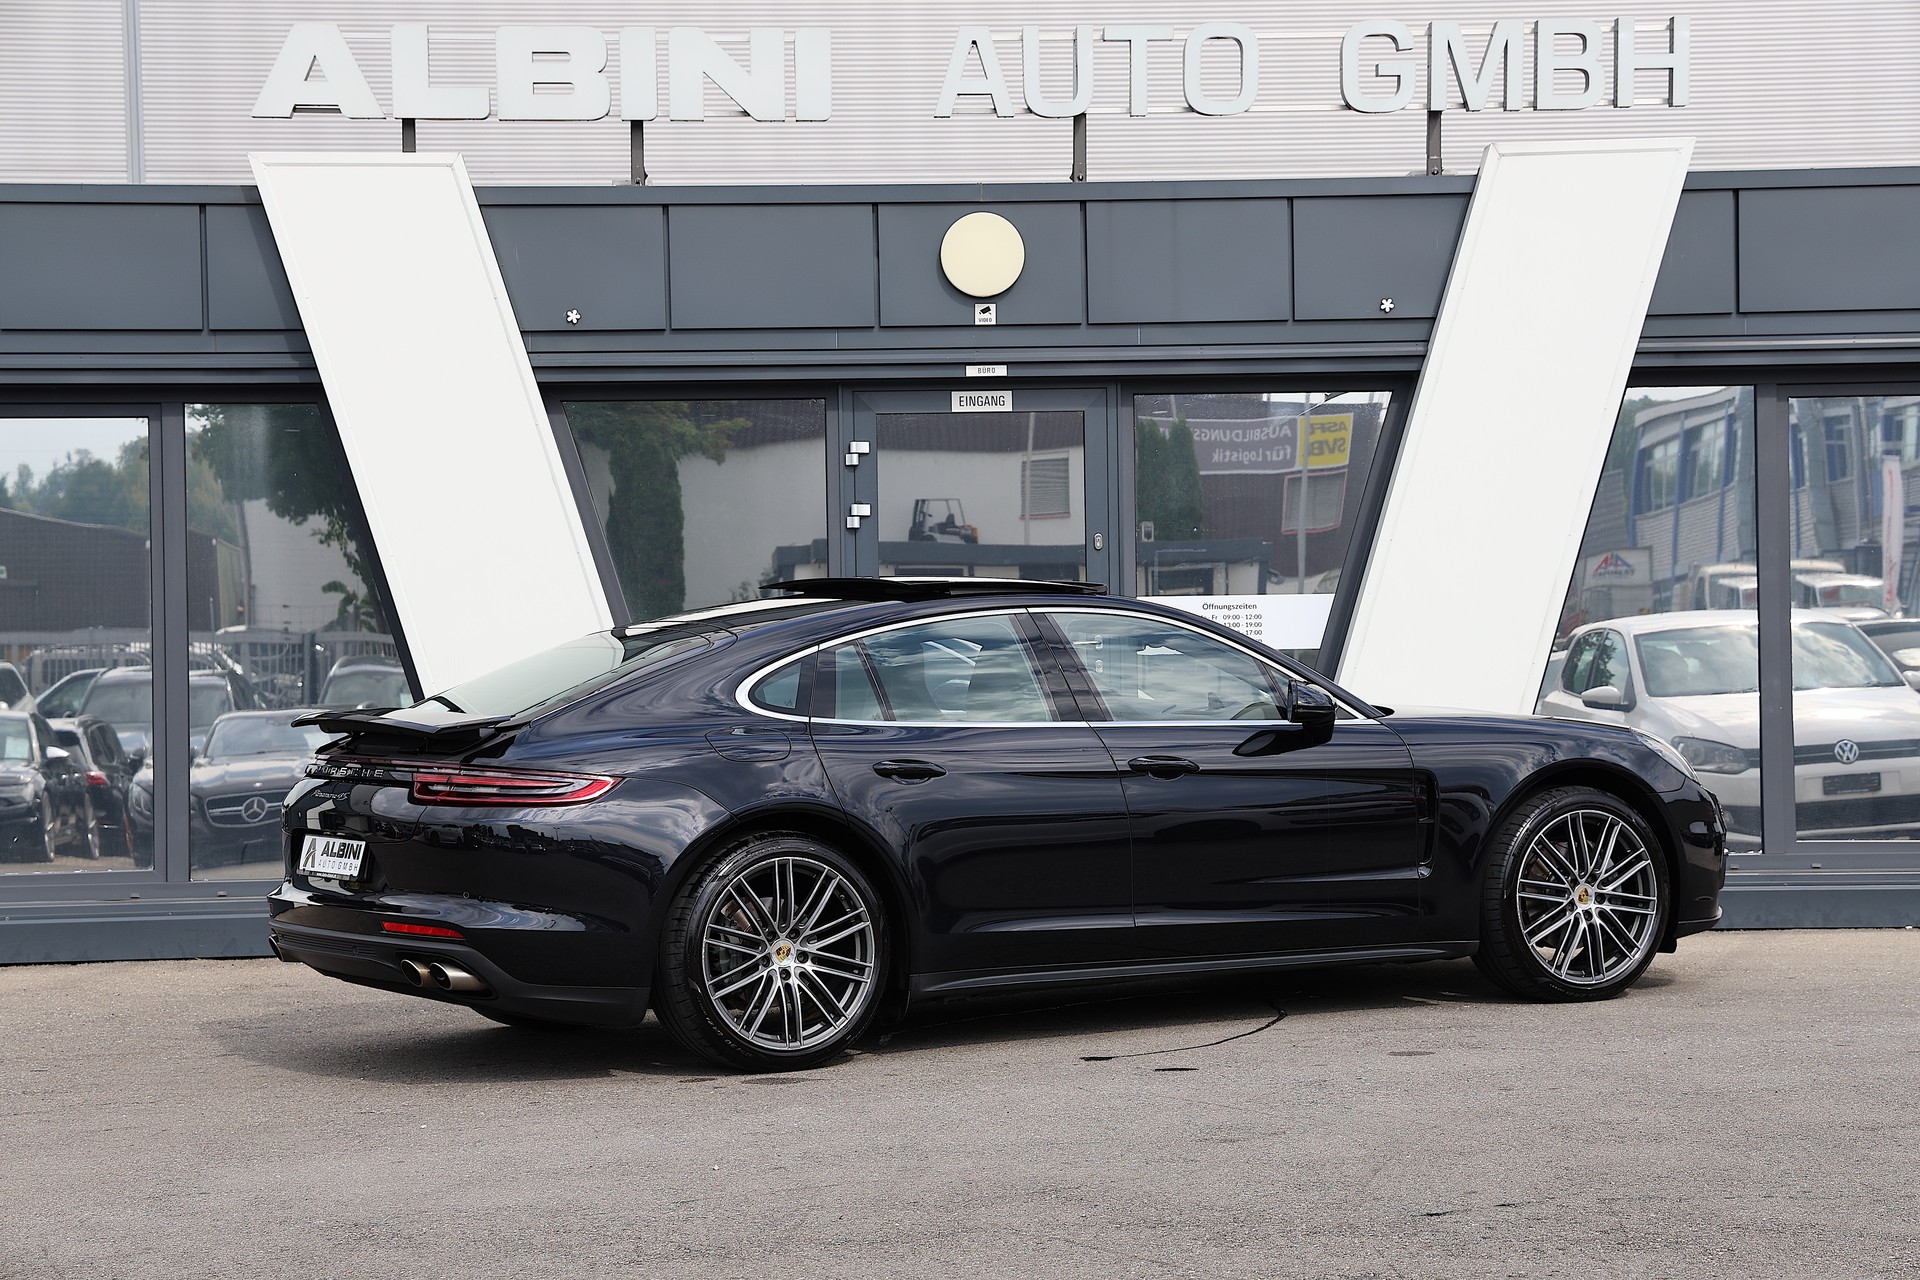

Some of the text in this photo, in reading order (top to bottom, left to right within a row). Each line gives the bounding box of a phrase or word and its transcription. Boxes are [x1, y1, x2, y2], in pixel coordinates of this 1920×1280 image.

[251, 16, 1690, 122] ALBINI AUTO GMBH
[977, 366, 996, 374] BÜRO
[959, 395, 1006, 407] EINGANG
[1202, 602, 1257, 611] Öffnungszeiten
[321, 841, 363, 861] ALBINI
[318, 859, 359, 872] AUTO GMBH
